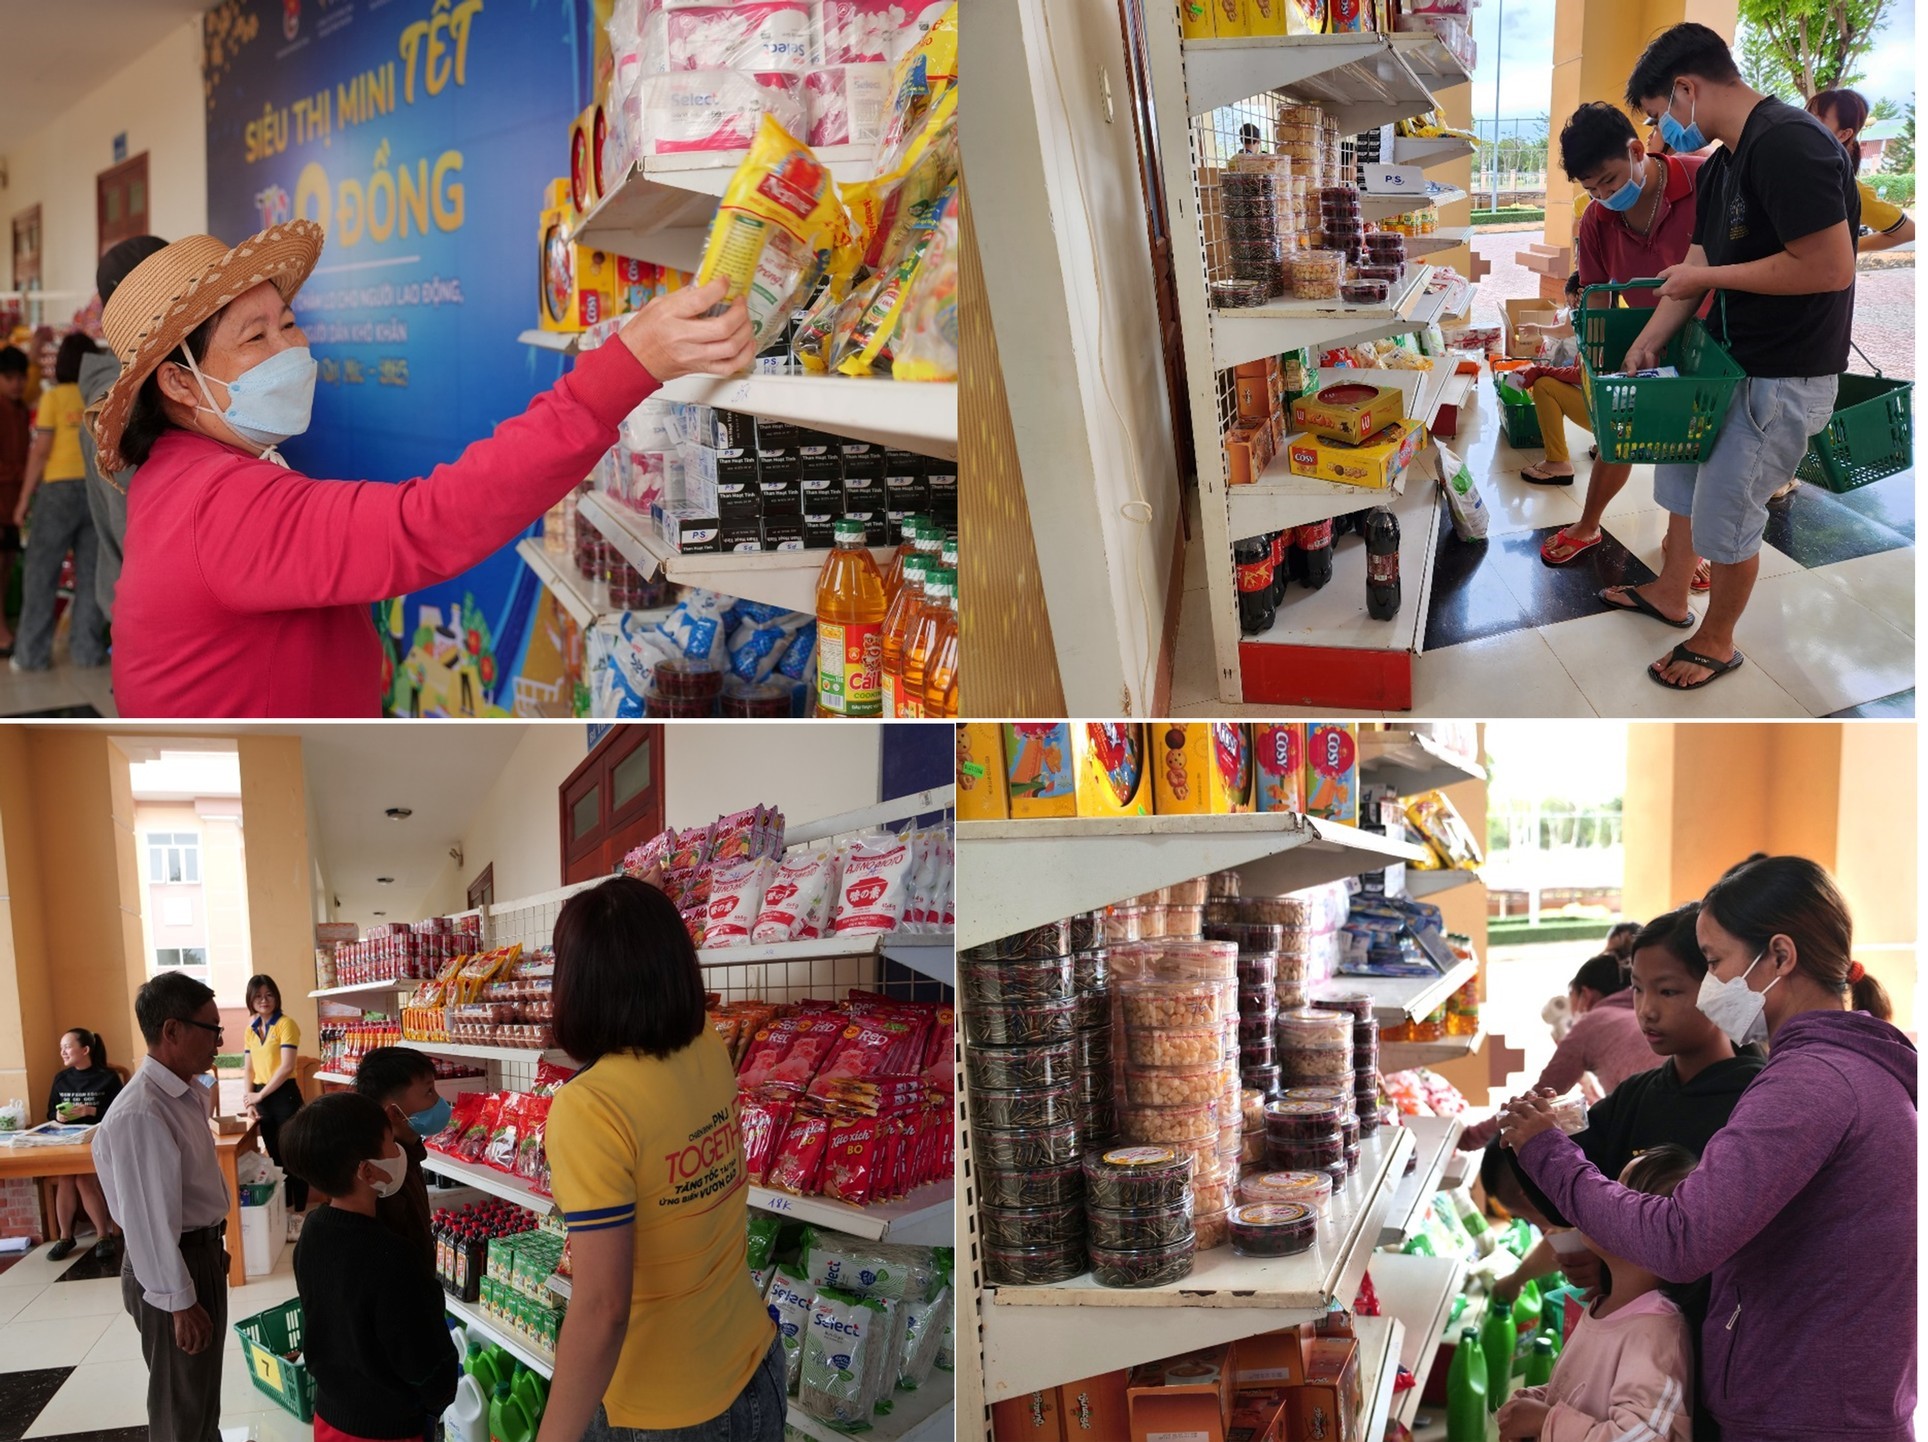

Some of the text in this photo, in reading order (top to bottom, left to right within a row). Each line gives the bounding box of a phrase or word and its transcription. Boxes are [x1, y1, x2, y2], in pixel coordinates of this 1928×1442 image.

[245, 102, 288, 164] SIÊU
[293, 89, 331, 148] THỊ
[337, 61, 395, 130] MINI
[335, 138, 464, 248] ĐỒNG
[1361, 415, 1370, 431] LU
[1294, 453, 1315, 463] COSY
[1276, 732, 1289, 768] COSY
[1327, 732, 1340, 769] COSY
[845, 854, 904, 874] AJINOMOTO
[712, 1107, 729, 1127] PNJ
[824, 1260, 841, 1286] elect
[771, 1284, 812, 1311] Select
[814, 1313, 860, 1337] Select
[261, 1359, 270, 1377] 7
